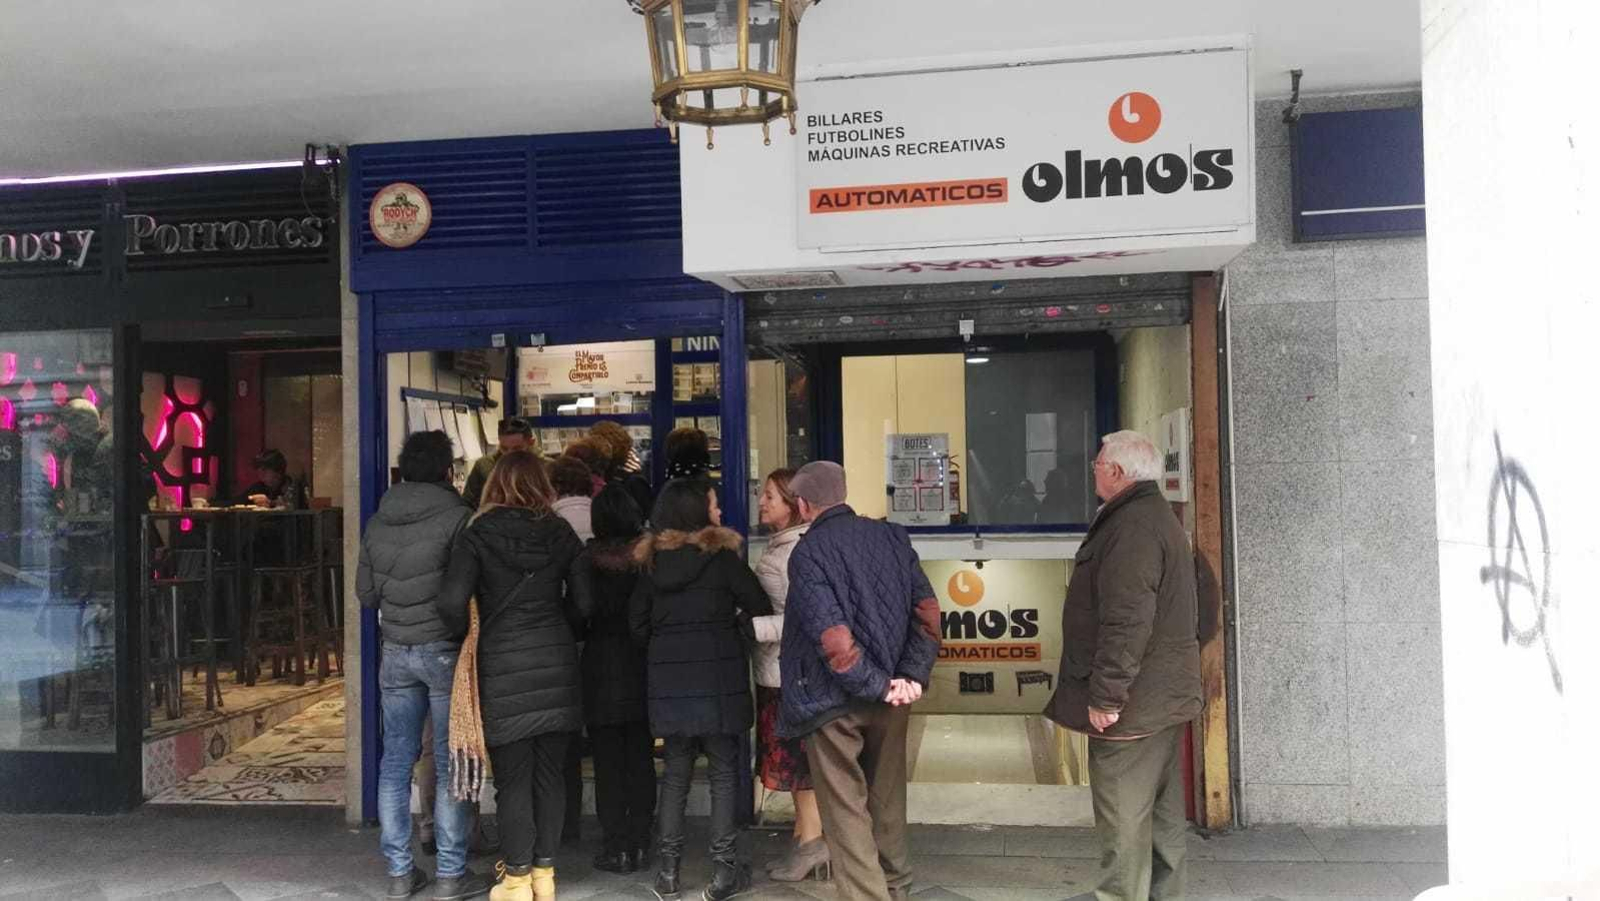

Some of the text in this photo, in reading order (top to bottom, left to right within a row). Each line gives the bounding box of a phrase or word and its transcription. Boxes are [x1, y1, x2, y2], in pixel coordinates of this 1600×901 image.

[807, 110, 884, 128] BILLARES
[808, 126, 906, 145] FUTBOLINES
[808, 136, 1006, 163] MÁQUINAS RECREATIVAS
[816, 182, 1004, 209] AUTOMATICOS
[123, 213, 324, 255] Porrones
[904, 437, 929, 450] BOTES
[940, 607, 1039, 640] mos
[938, 645, 1038, 659] OMATICOS
